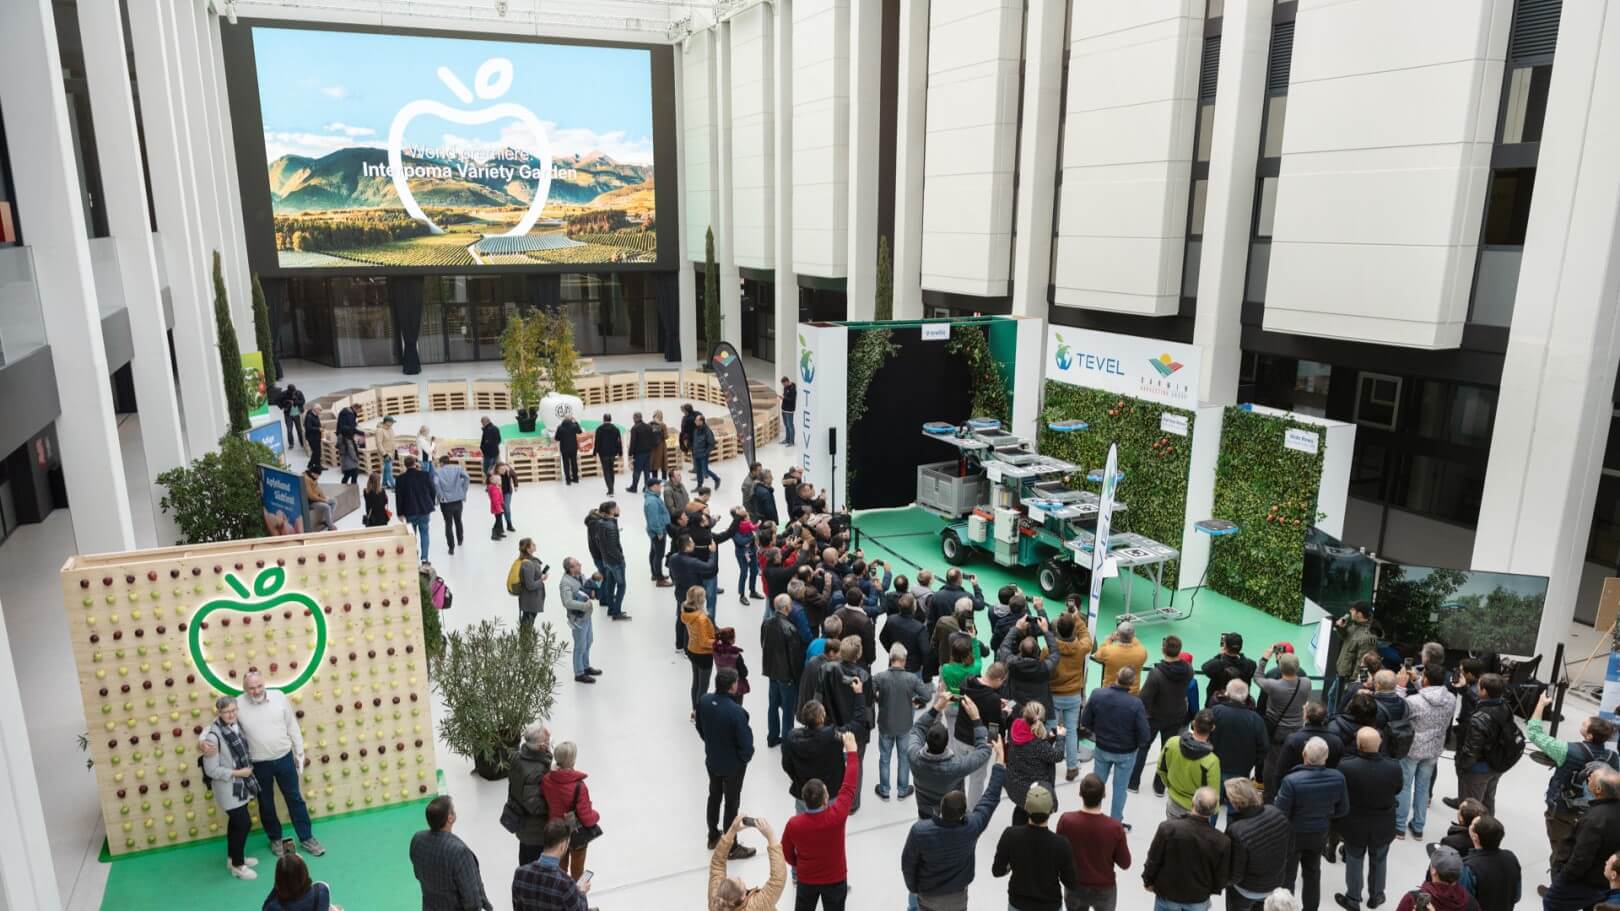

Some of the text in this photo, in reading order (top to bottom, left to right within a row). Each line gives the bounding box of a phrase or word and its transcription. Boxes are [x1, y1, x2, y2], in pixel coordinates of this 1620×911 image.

[362, 161, 577, 182] Intepoma Variety Gaden
[1076, 353, 1125, 375] TEVEL
